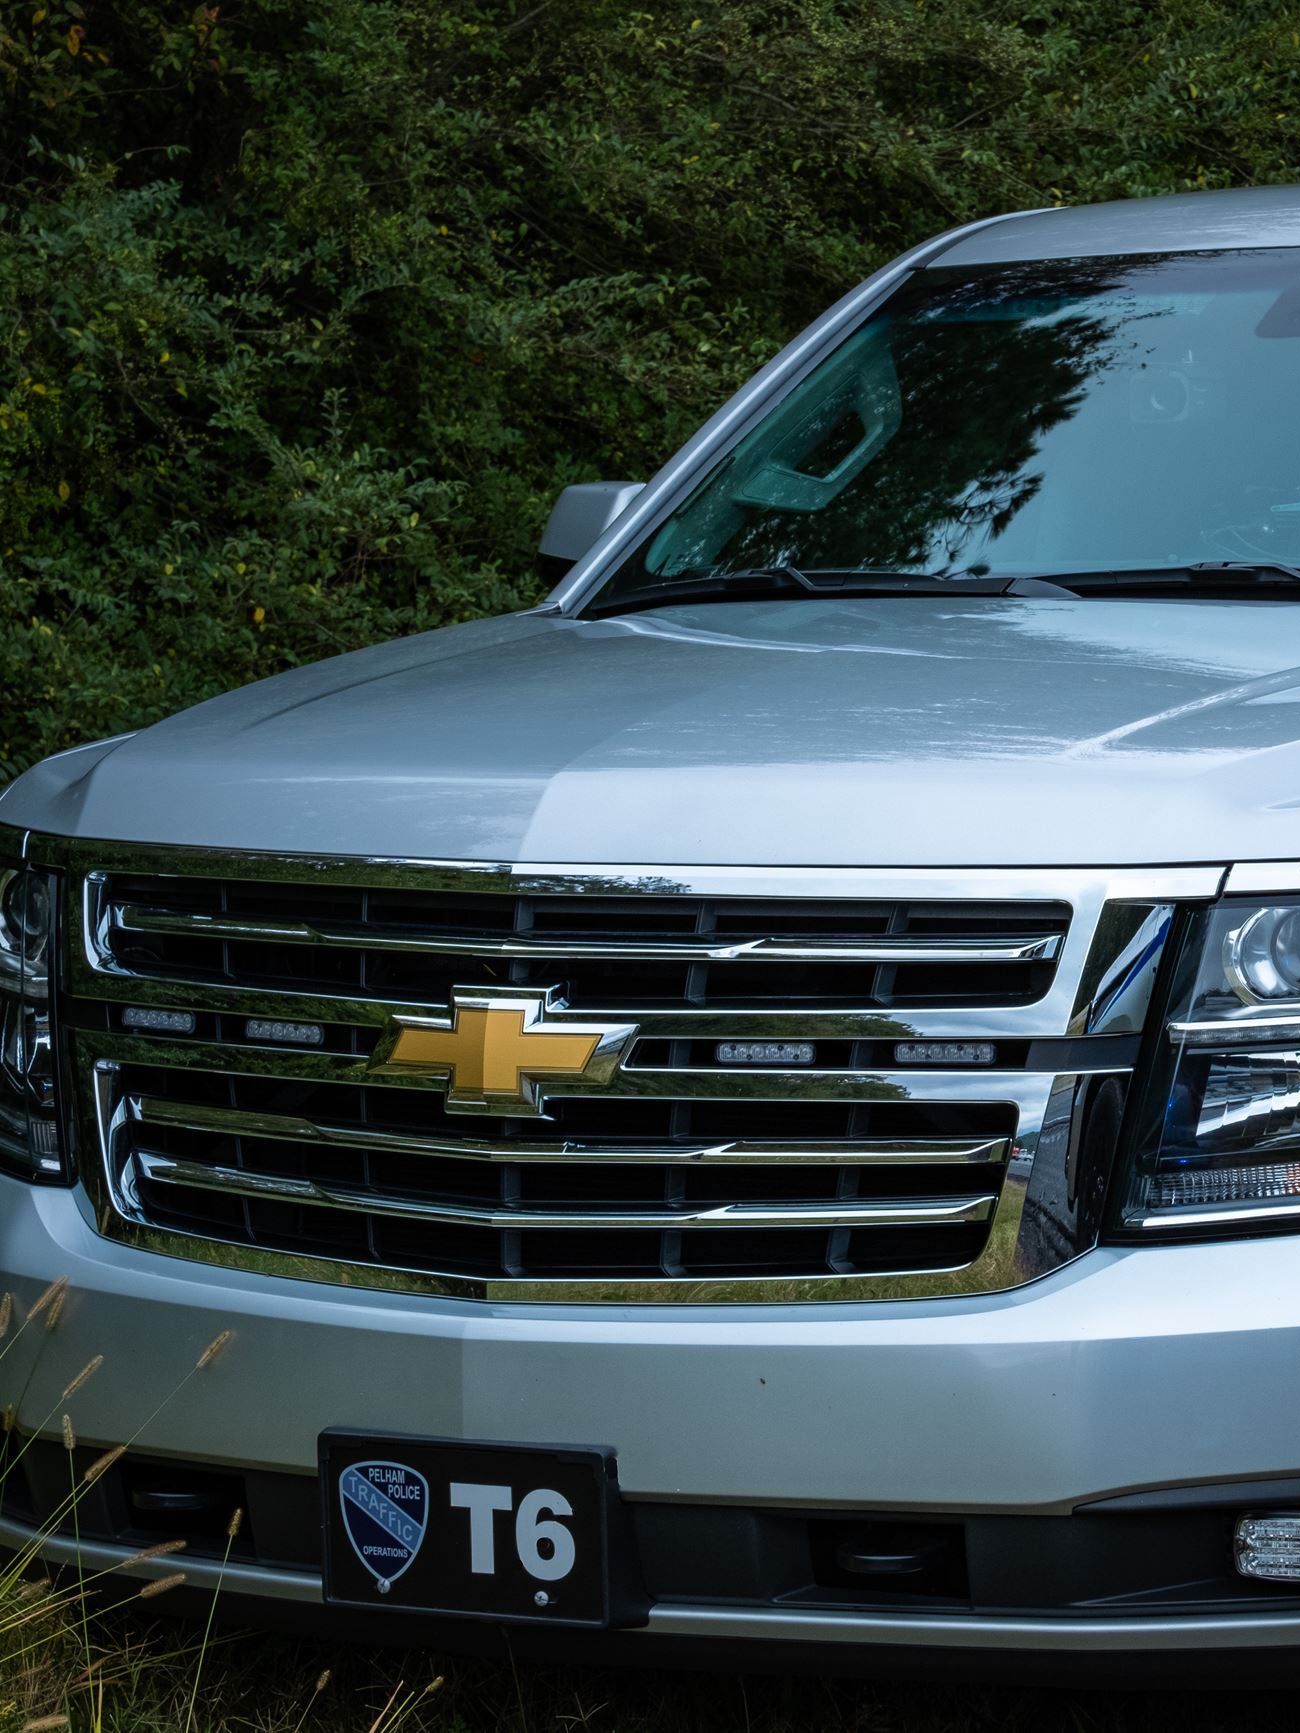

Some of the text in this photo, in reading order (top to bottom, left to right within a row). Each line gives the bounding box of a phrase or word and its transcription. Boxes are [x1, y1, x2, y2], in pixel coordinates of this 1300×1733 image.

[368, 1467, 406, 1484] PELHAM
[387, 1484, 421, 1500] POLICE
[348, 1476, 413, 1541] TRAFFIC
[450, 1482, 576, 1582] T6
[362, 1545, 409, 1559] OPERATIONS
